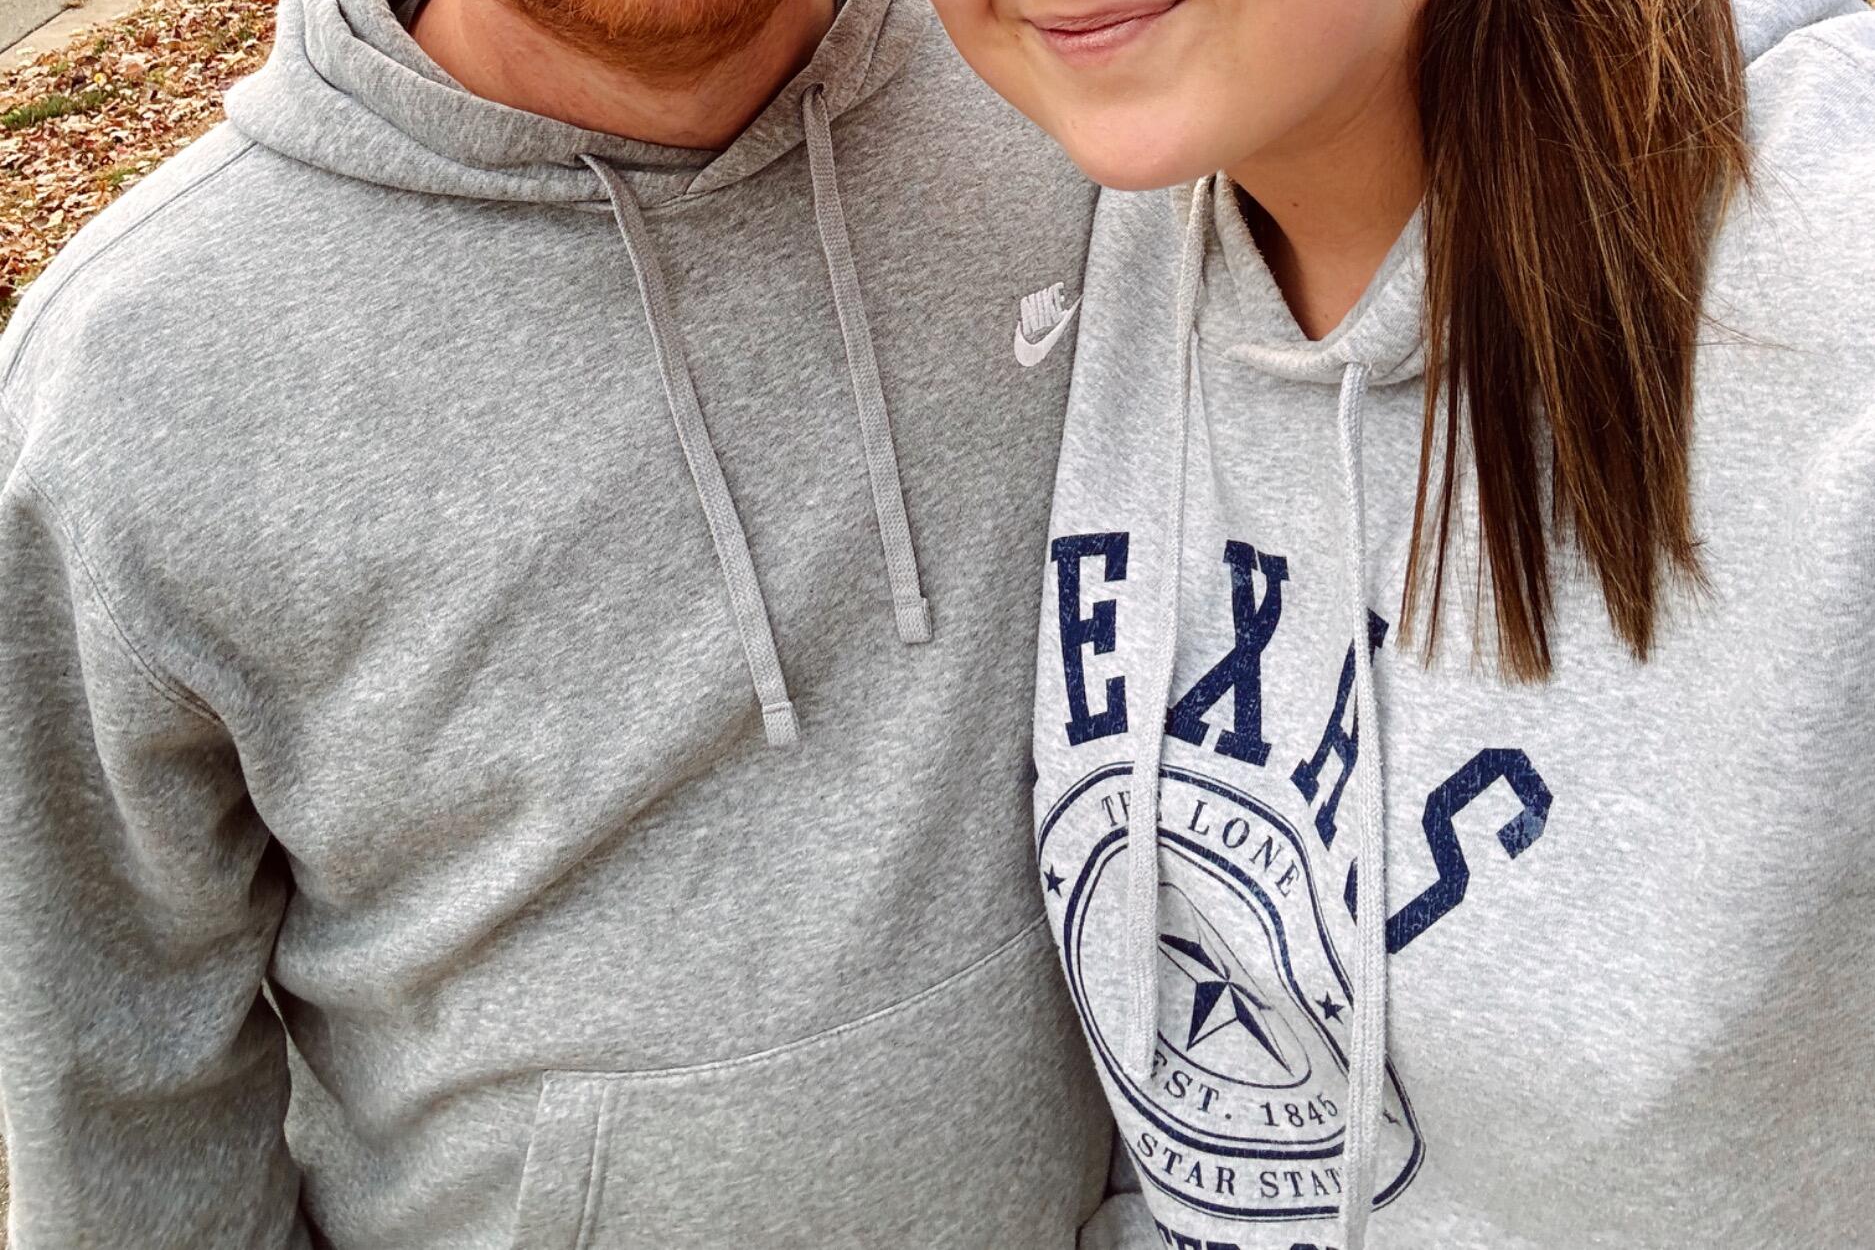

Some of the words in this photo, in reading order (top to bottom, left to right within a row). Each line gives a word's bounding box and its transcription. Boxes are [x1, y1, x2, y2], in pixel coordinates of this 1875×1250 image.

[1188, 799, 1300, 898] LONE
[1260, 1092, 1339, 1128] 1845
[1137, 1132, 1237, 1196] STAR
[1260, 1165, 1344, 1198] STAT
